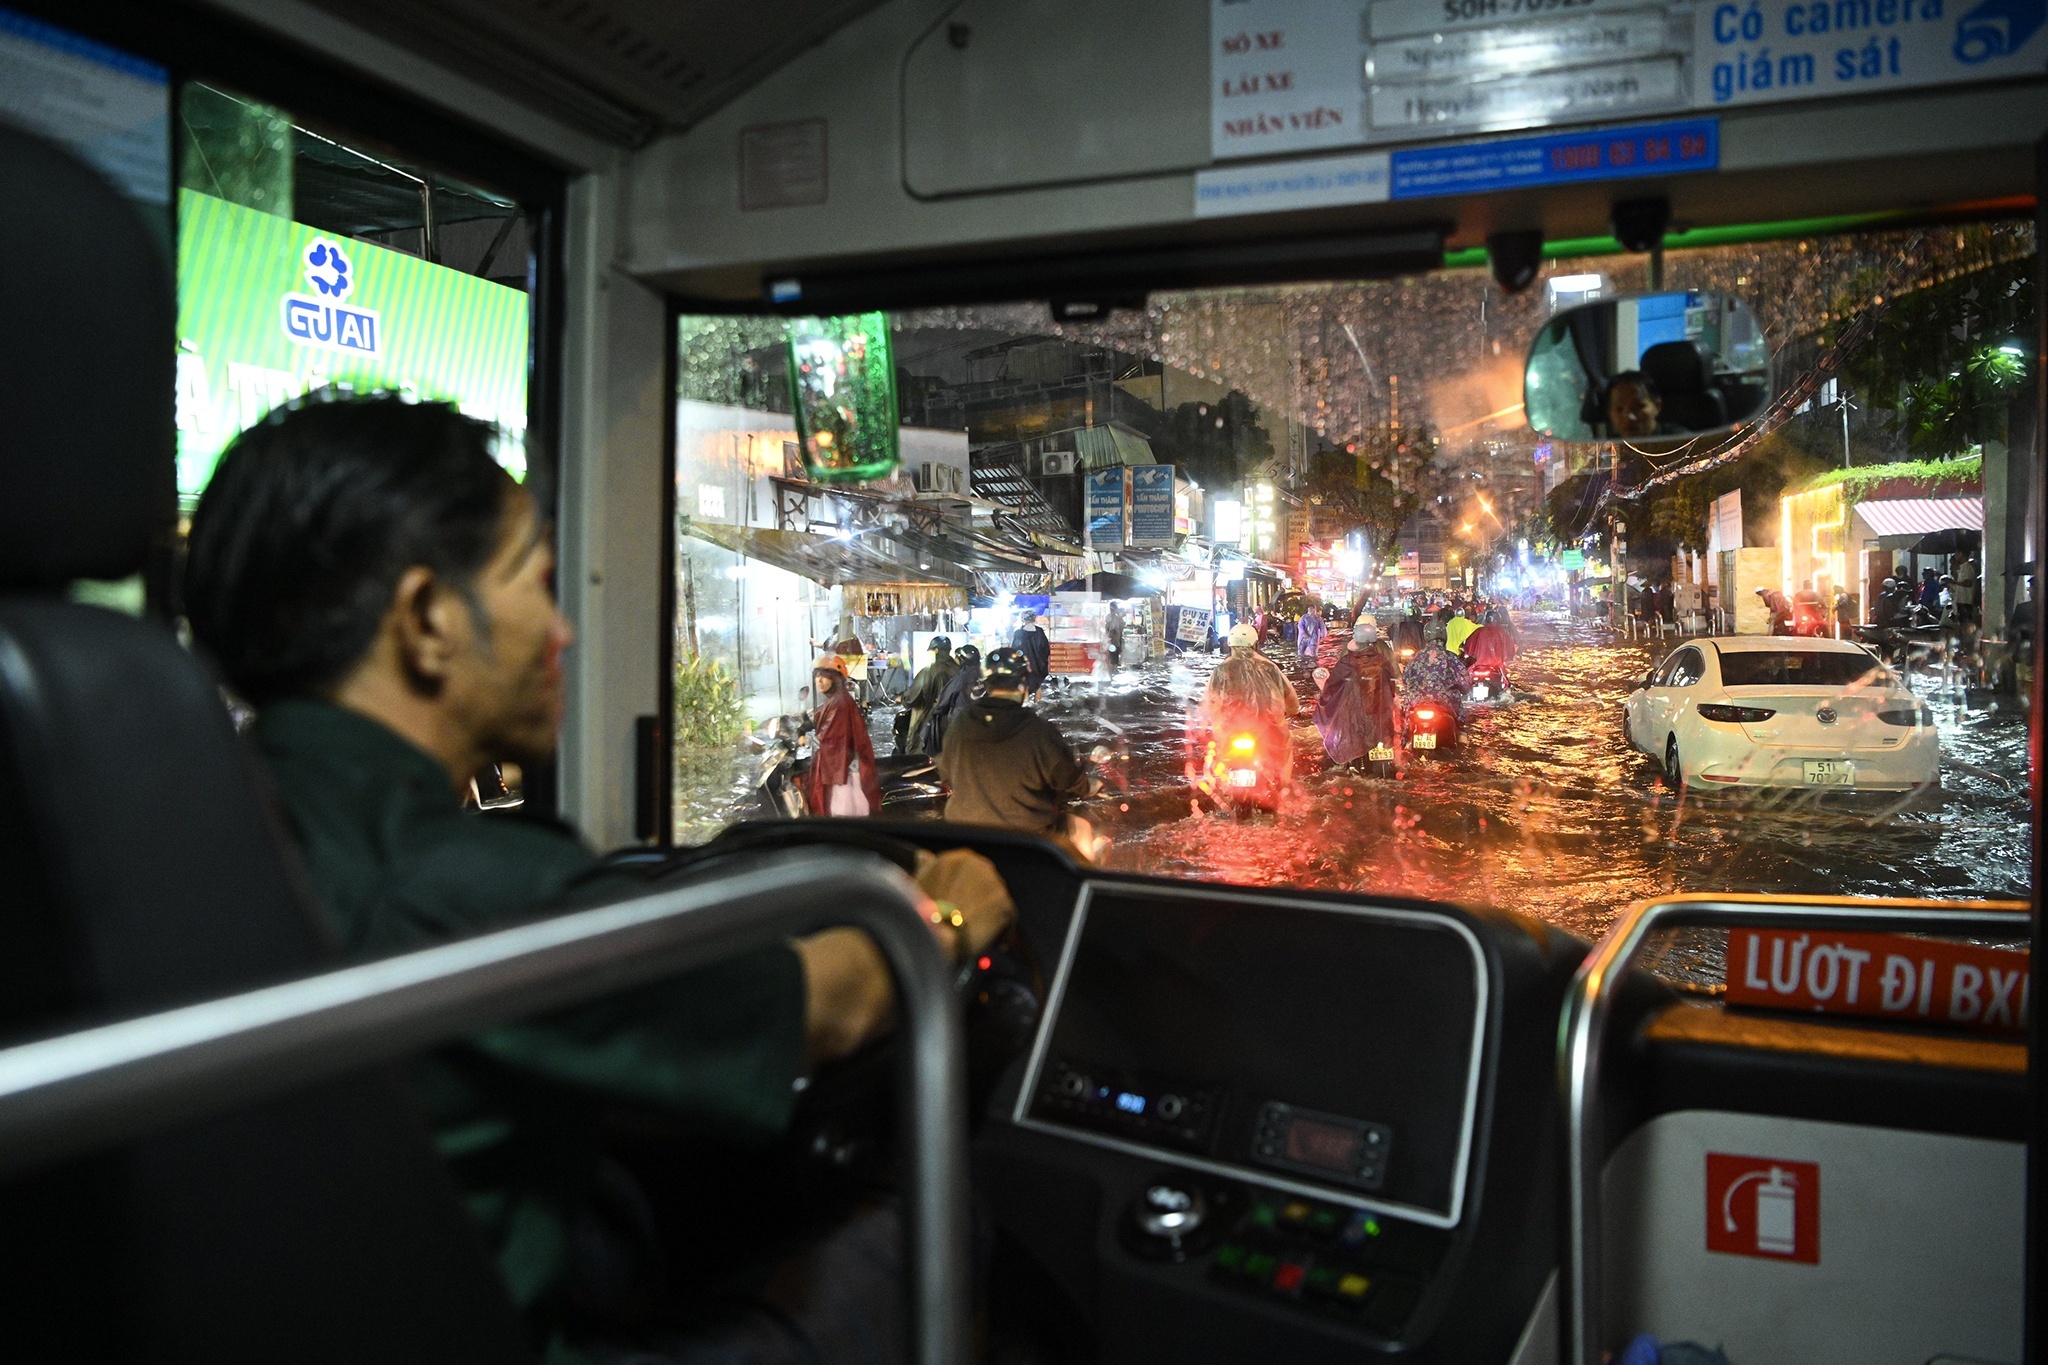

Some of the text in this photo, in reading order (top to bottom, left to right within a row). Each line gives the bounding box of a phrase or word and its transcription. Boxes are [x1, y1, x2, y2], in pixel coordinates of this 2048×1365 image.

[1785, 0, 1945, 36] camera
[1267, 71, 1294, 92] XE
[1713, 35, 1900, 102] giám sát
[1198, 611, 1208, 621] XE
[1745, 934, 2030, 1027] LƯỢT ĐI BX
